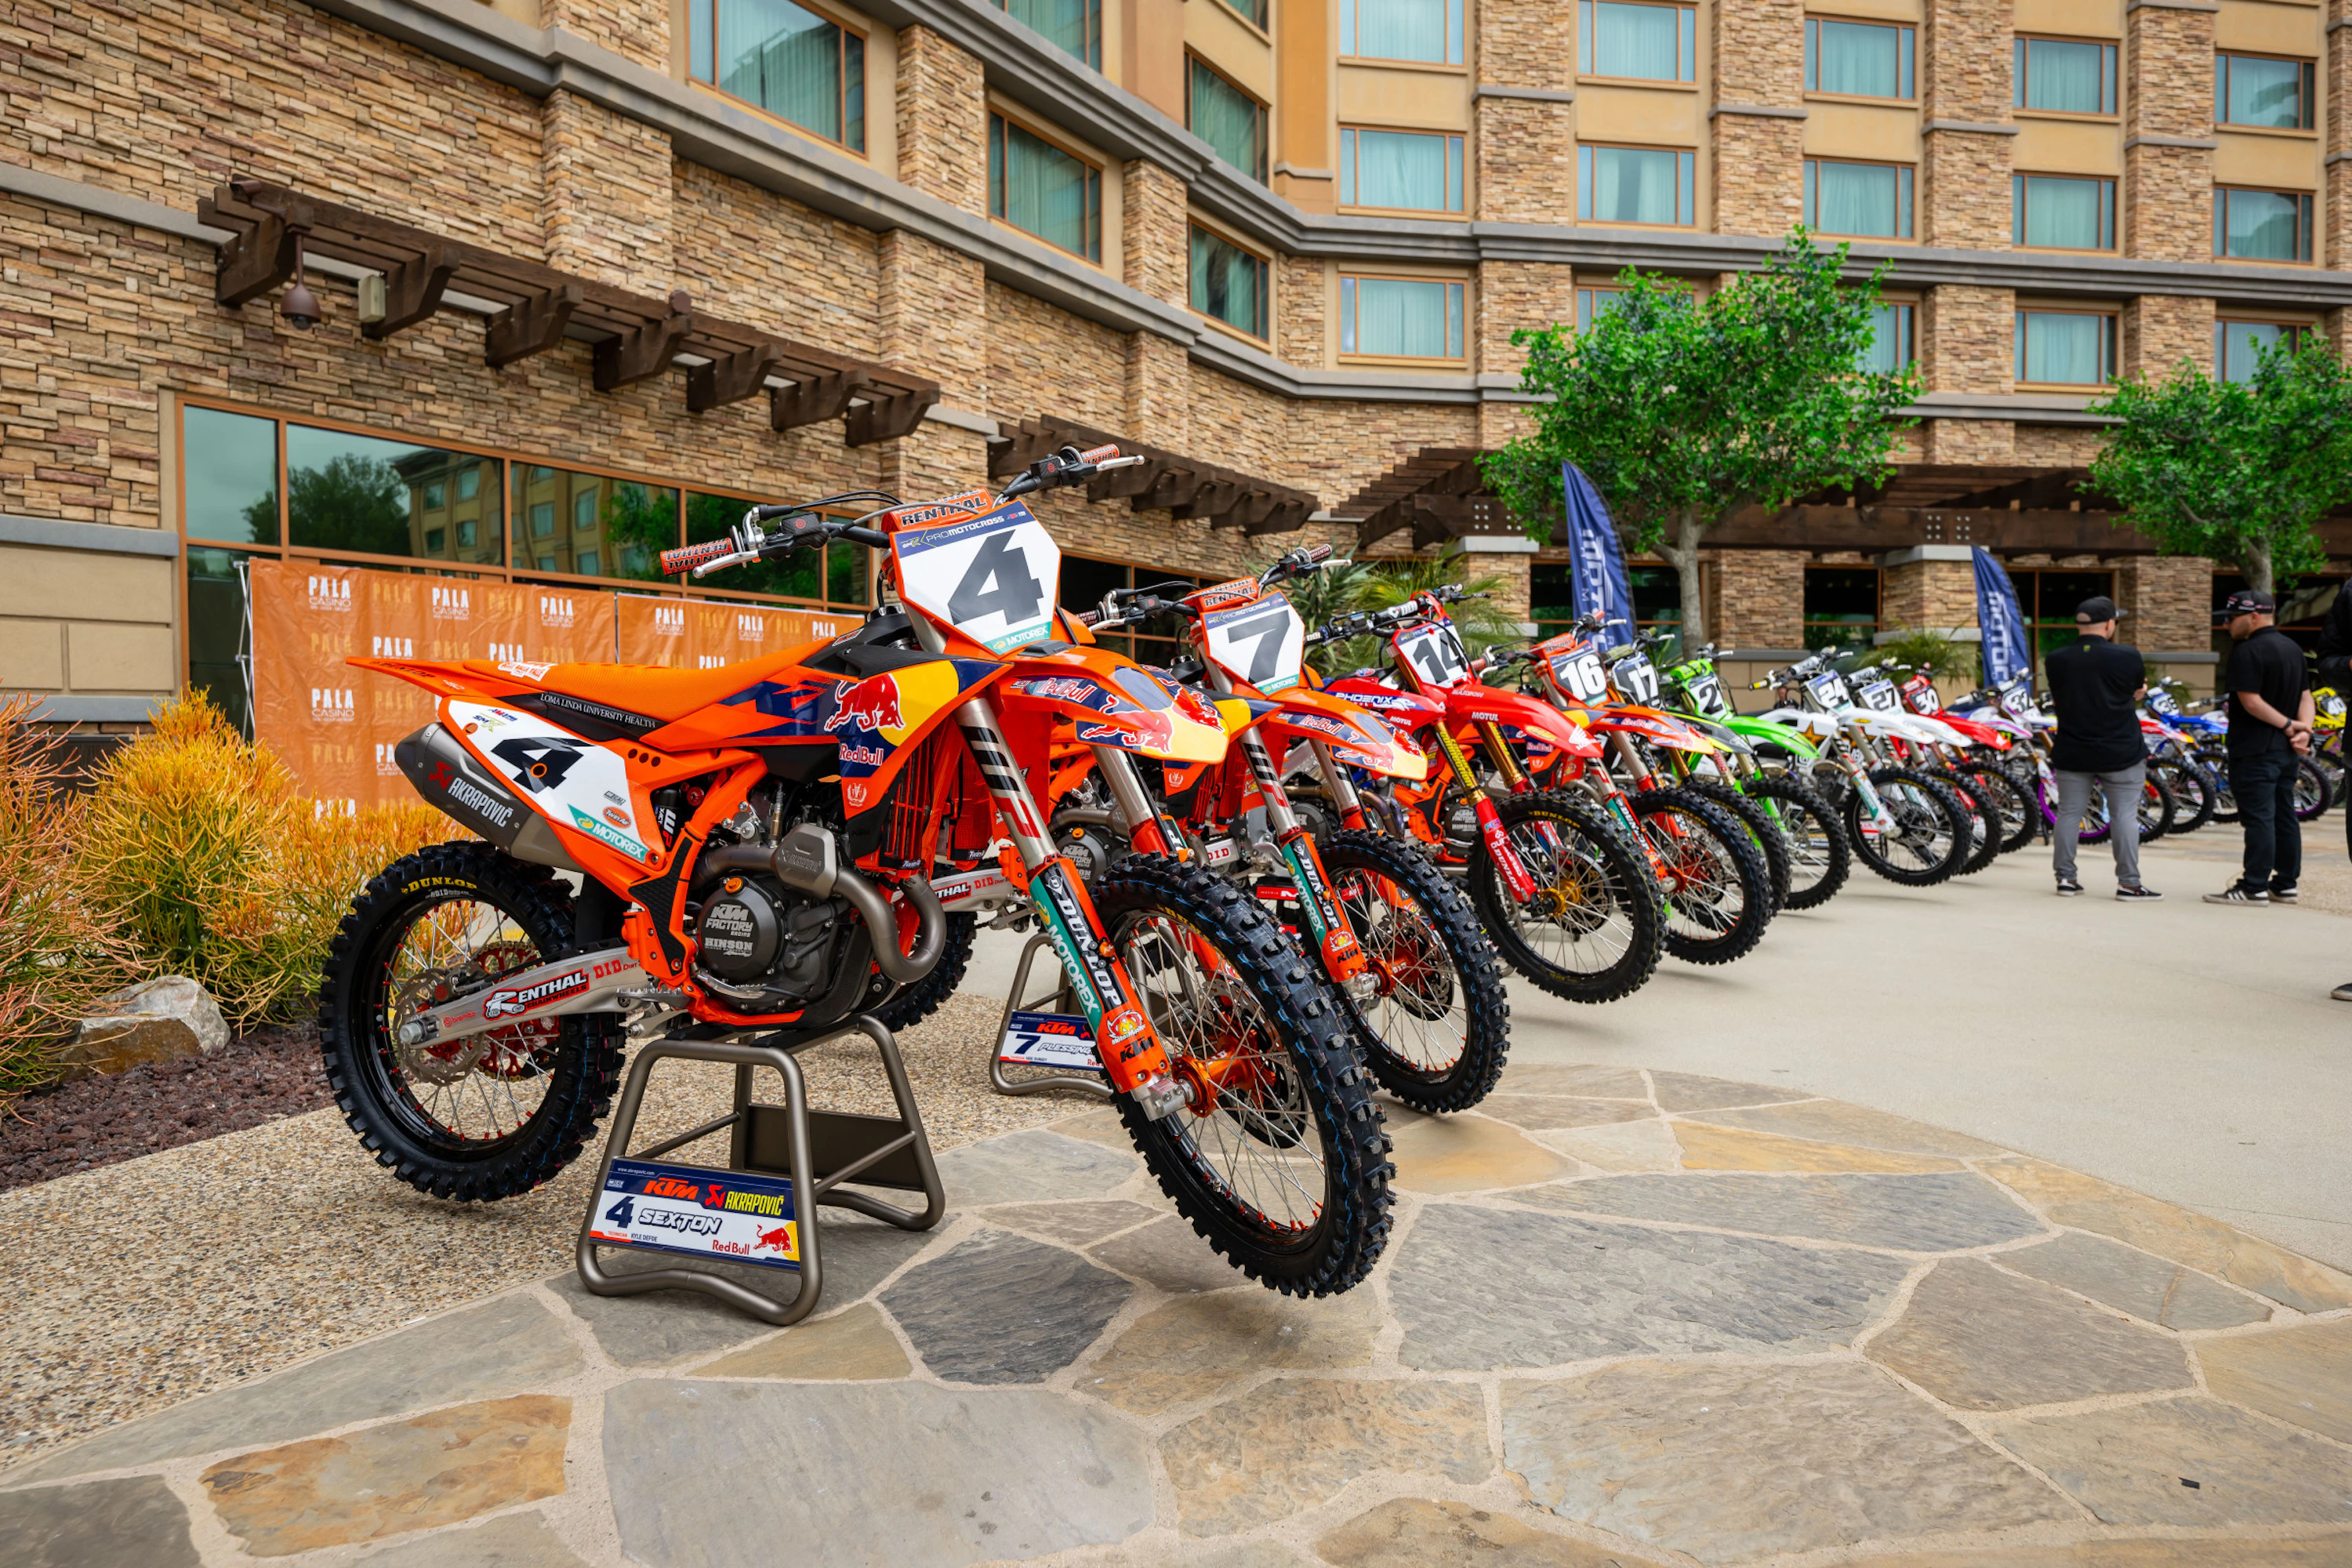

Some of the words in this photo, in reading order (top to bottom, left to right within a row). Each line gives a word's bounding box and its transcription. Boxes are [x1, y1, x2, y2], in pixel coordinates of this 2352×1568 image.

[902, 495, 987, 527] RENTHAL
[663, 543, 728, 561] RENTHAL
[309, 575, 351, 598] PALA
[947, 528, 1044, 626] 4
[309, 597, 351, 608] CASINO
[432, 587, 469, 608] PALA
[541, 597, 573, 616] PALA
[433, 607, 470, 615] CASINO
[655, 608, 684, 626] PALA
[738, 615, 764, 631] PALA
[813, 622, 836, 637] PALA
[1007, 625, 1048, 645] MOTOREX
[373, 636, 412, 657] PALA
[489, 643, 524, 662] PALA
[1227, 610, 1290, 684] 7
[699, 655, 725, 669] PALA
[1413, 631, 1463, 684] 14
[1560, 654, 1606, 701] 16
[1628, 663, 1659, 703] 17
[311, 688, 354, 709] PALA
[1039, 677, 1063, 696] Red
[1059, 679, 1097, 703] Bull
[1335, 692, 1394, 705] PHOENIX
[1817, 681, 1849, 707] 24
[1871, 687, 1896, 710] 27
[541, 693, 561, 706] LOMA
[561, 699, 583, 712] LINDA
[583, 705, 624, 721] UNIVERSITY
[624, 714, 656, 728] HEALTH
[1915, 688, 1939, 714] 30
[312, 708, 354, 717] CASINO
[1389, 716, 1412, 726] MOTUL
[1472, 712, 1499, 721] MOTUL
[1301, 714, 1321, 728] Red
[1318, 717, 1343, 735] Bull
[376, 744, 396, 763] PA
[839, 744, 859, 764] Red
[859, 746, 884, 767] Bull
[491, 736, 596, 794] 4
[448, 776, 514, 829] AKRAPOVIČ
[1534, 810, 1581, 828] DUNLOP
[592, 825, 644, 858] MOTOREX
[1062, 844, 1089, 858] KTM
[1492, 848, 1523, 892] DUNLOP
[408, 877, 477, 893] DUNLOP
[935, 883, 971, 898] THAL
[710, 903, 749, 921] KTM
[1293, 874, 1326, 933] MOTOREX
[706, 918, 753, 933] FACTORY
[705, 938, 753, 950] HINSON
[1337, 949, 1359, 964] KTM
[1047, 925, 1101, 1014] MOTOREX
[484, 972, 588, 1019] RENTHAL
[526, 983, 587, 1009] CHAINWHEELS
[452, 1010, 477, 1024] brembo
[1036, 1021, 1076, 1036] KTM
[1014, 1033, 1041, 1055] 7
[1120, 1036, 1154, 1063] KTM
[643, 1177, 699, 1200] KTM
[724, 1190, 785, 1216] AKRAPOVIČ
[605, 1196, 635, 1229] 4
[638, 1207, 722, 1236] SEXTON
[712, 1240, 730, 1251] Red
[731, 1242, 750, 1255] Bull
